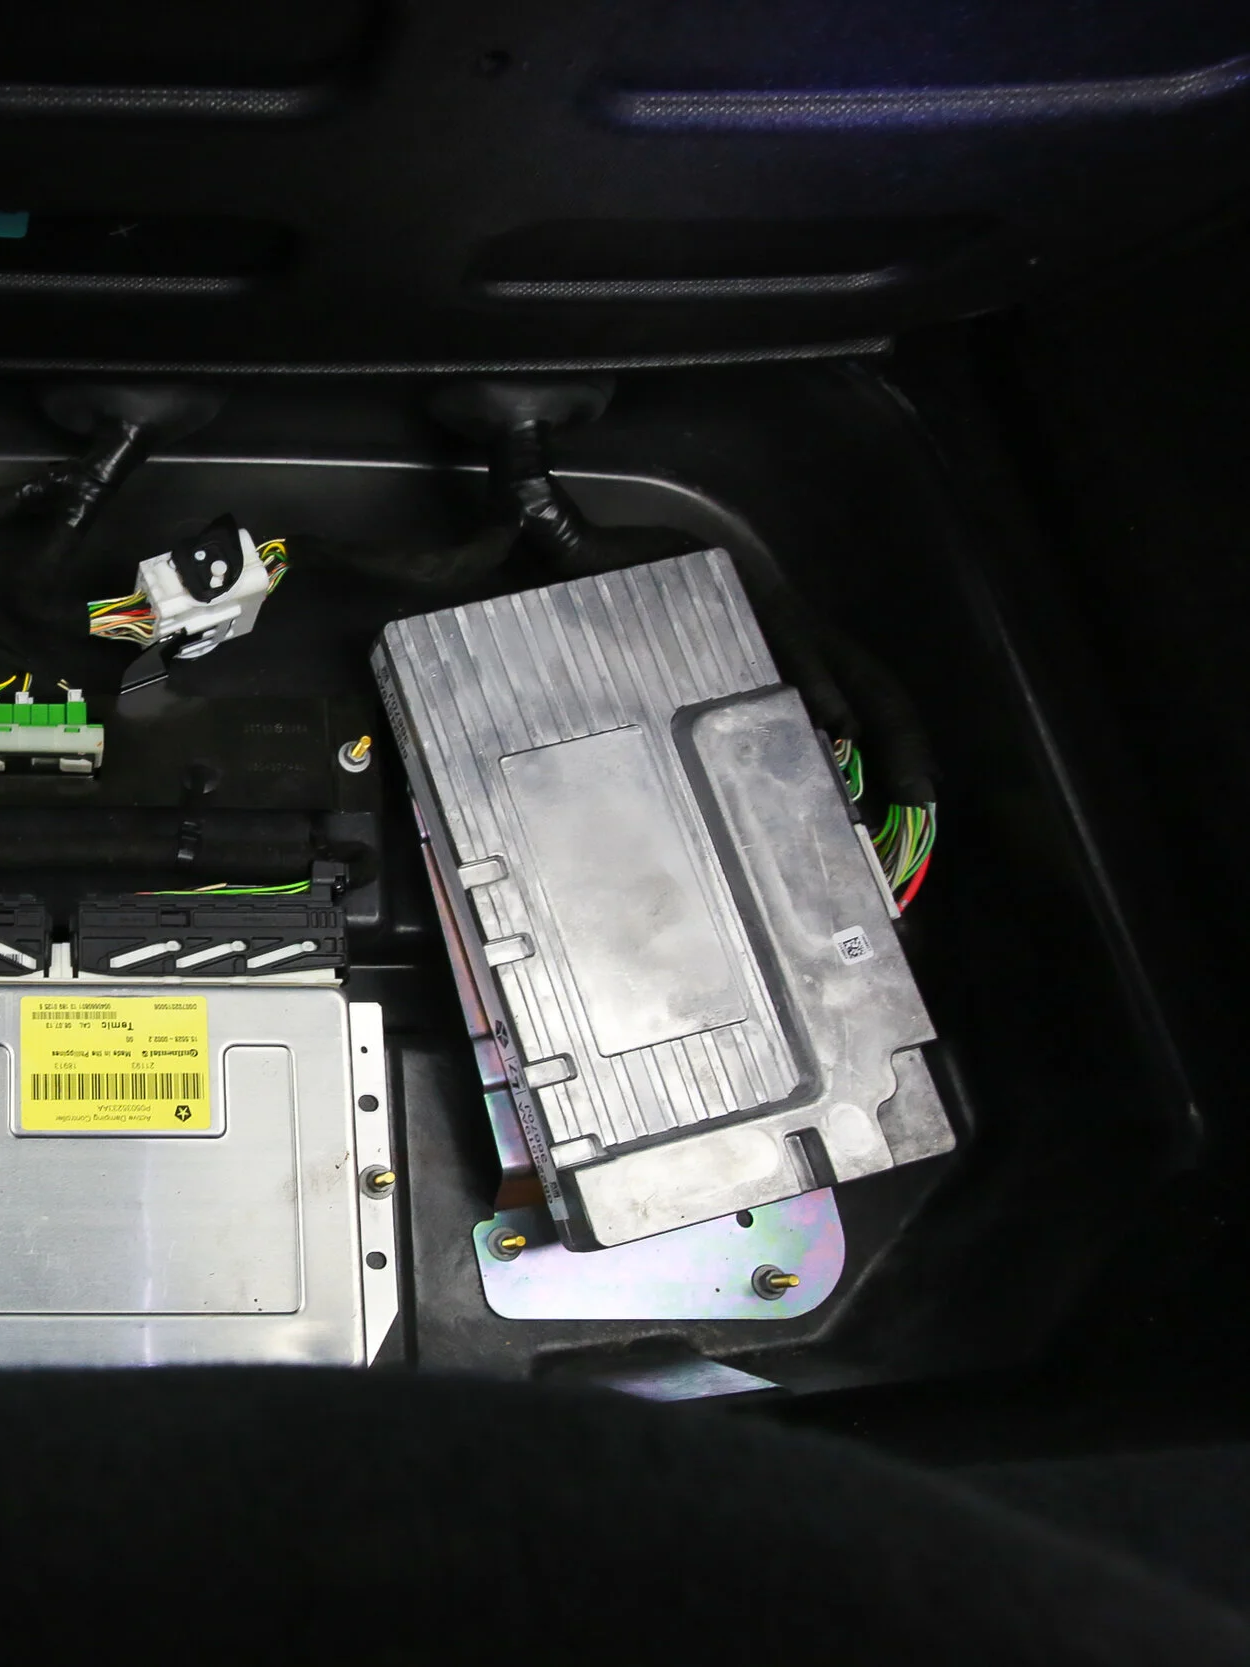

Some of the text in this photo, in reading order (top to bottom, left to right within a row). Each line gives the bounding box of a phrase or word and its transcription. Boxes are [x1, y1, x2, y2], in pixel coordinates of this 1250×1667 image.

[101, 1021, 134, 1030] Temic
[52, 1049, 89, 1057] Philippines
[150, 1049, 198, 1058] Continental
[92, 1113, 126, 1122] Damping
